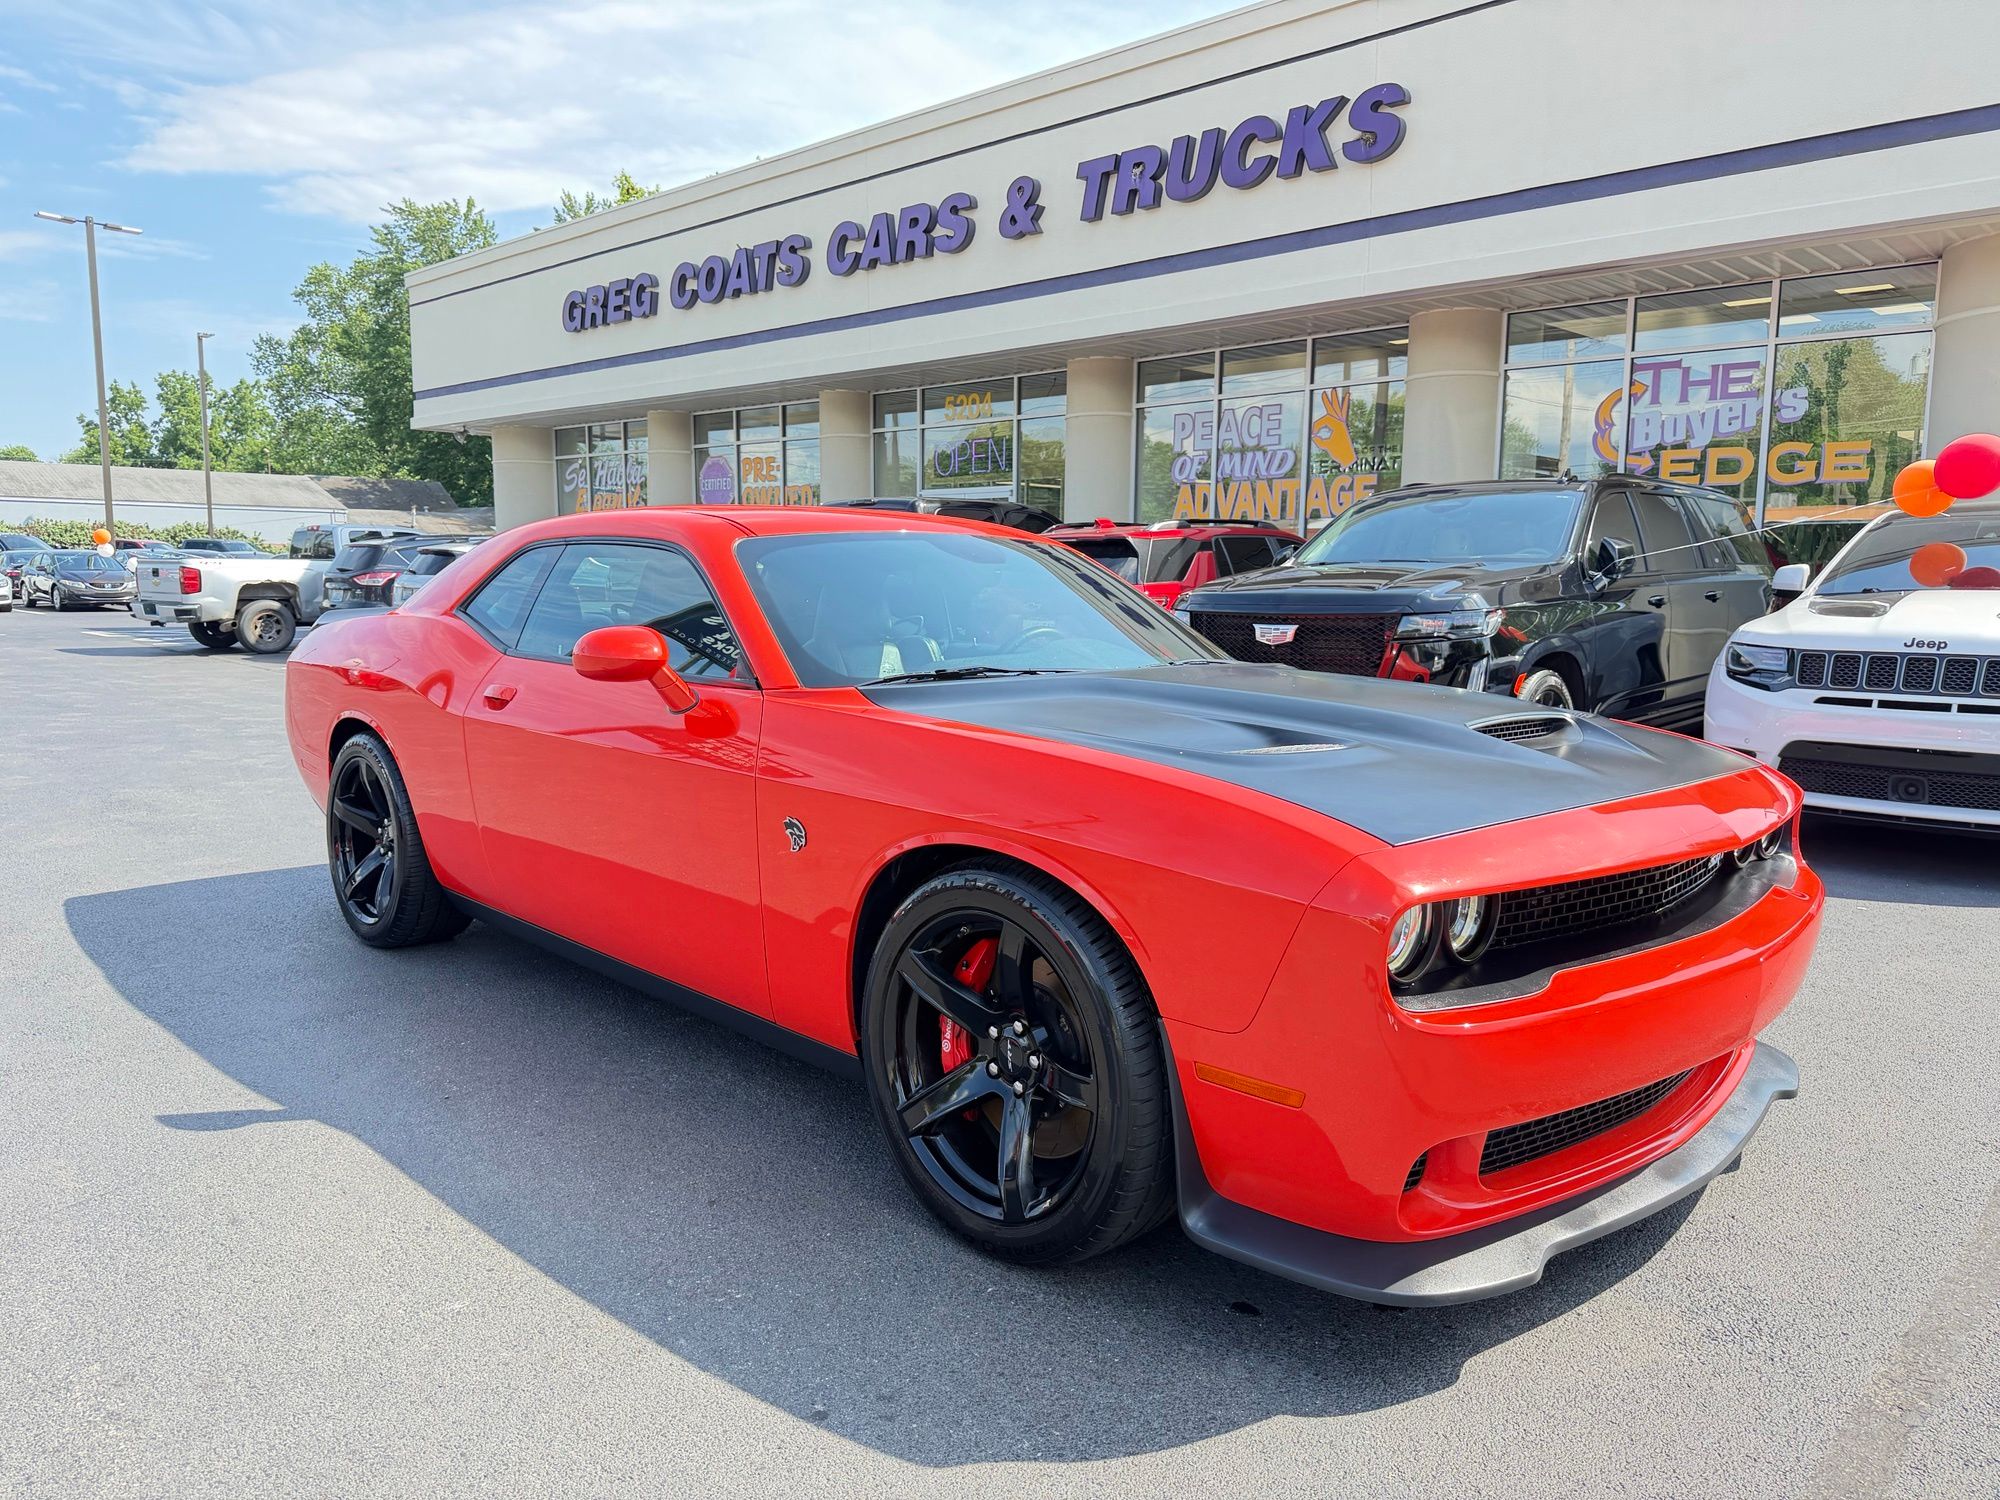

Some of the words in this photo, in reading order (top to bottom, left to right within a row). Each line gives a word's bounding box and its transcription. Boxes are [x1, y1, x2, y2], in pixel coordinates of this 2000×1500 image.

[562, 272, 660, 333] GREG
[670, 233, 812, 309] COATS
[826, 192, 978, 277] CARS
[999, 175, 1046, 240] &
[1076, 82, 1412, 223] TRUCKS
[1633, 358, 1761, 405] THE
[943, 391, 993, 421] 5204
[1173, 403, 1282, 452] PEACE
[741, 456, 781, 483] PRE-
[933, 437, 1006, 477] OPEN
[1171, 453, 1208, 484] OF
[1217, 449, 1296, 481] MIND
[1658, 439, 1873, 486] EDGE
[563, 462, 587, 493] Se
[701, 478, 732, 491] CERTIFIED
[1173, 472, 1378, 521] ADVANTAGE
[1903, 637, 1948, 652] Jeep
